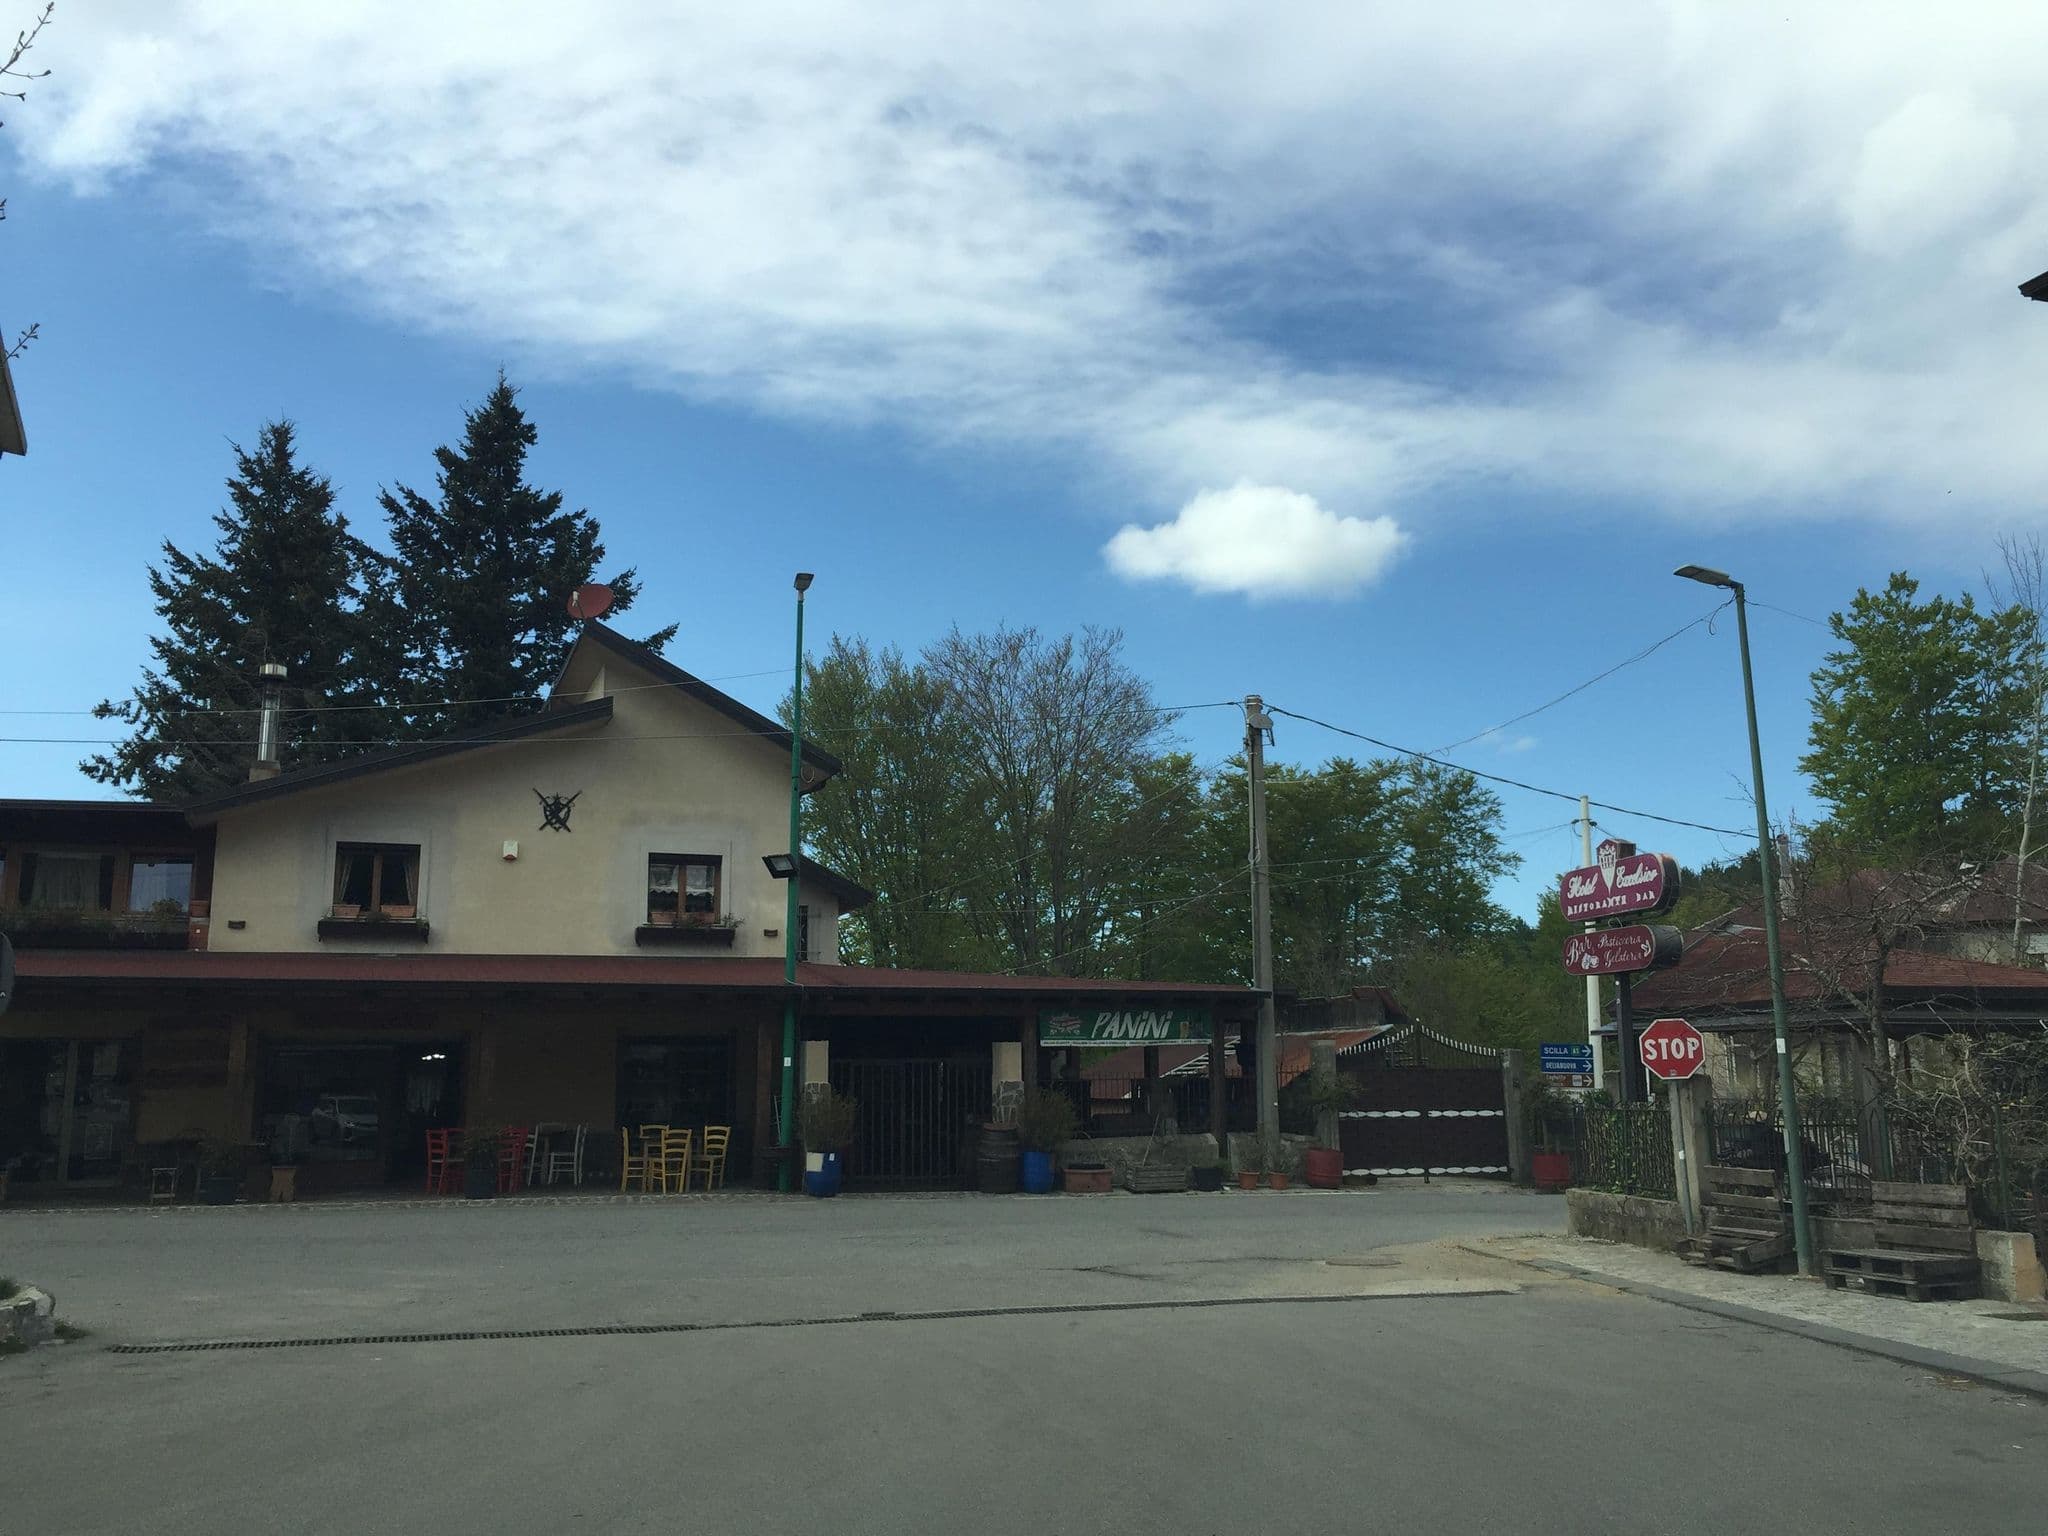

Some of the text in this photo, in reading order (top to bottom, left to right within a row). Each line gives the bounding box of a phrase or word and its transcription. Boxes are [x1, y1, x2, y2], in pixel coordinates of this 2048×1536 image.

[1567, 873, 1598, 899] Hotel
[1567, 890, 1656, 917] RISTORANTE BAR
[1566, 936, 1592, 967] Bar
[1543, 1046, 1569, 1055] SCILLA
[1644, 1037, 1700, 1060] STOP
